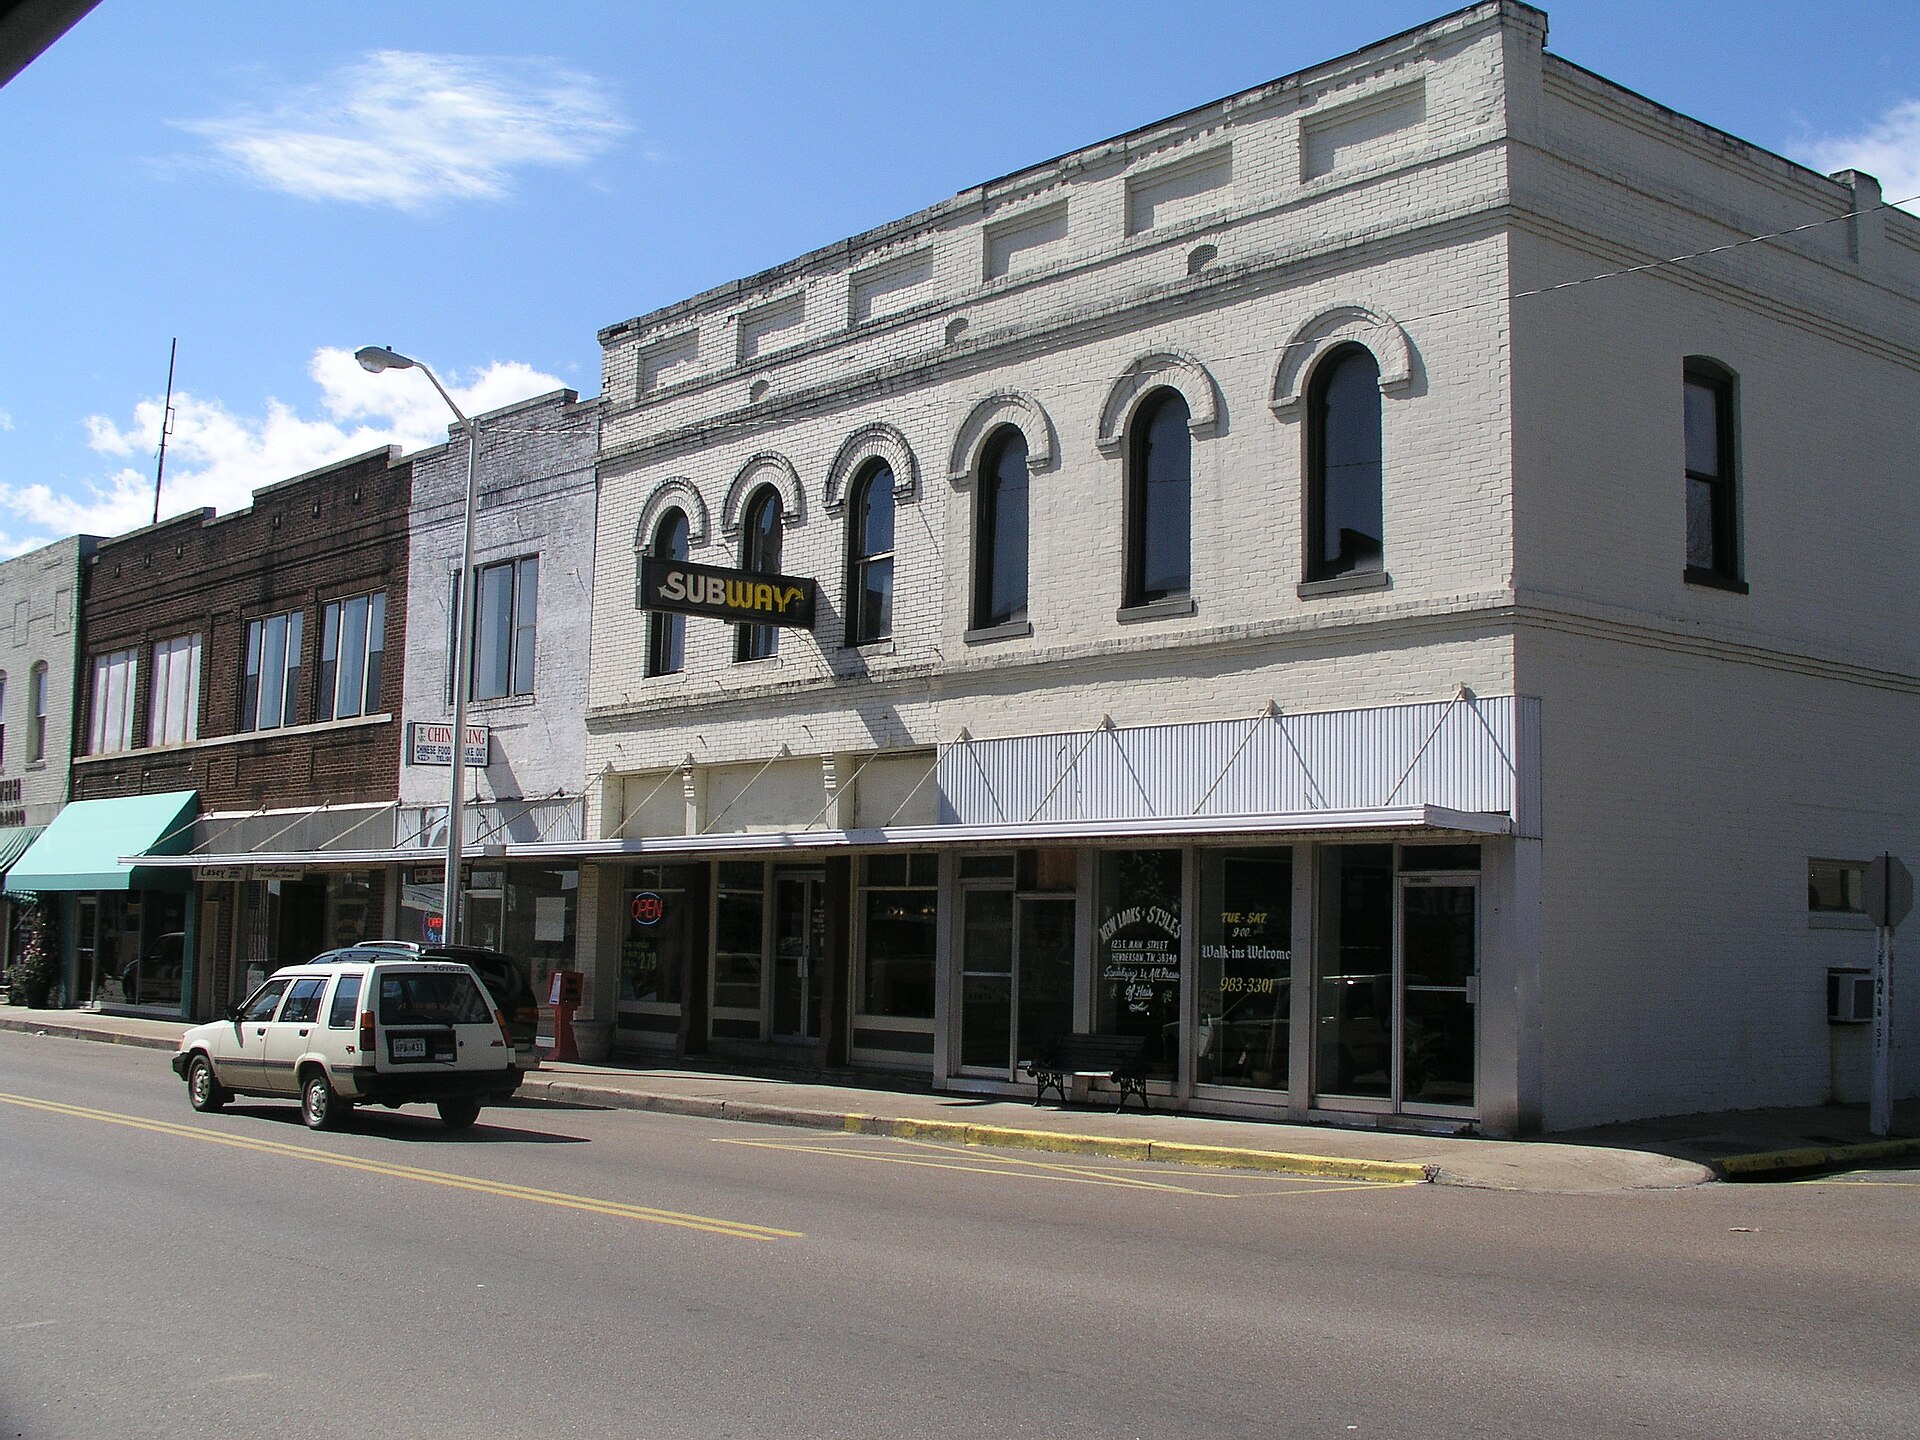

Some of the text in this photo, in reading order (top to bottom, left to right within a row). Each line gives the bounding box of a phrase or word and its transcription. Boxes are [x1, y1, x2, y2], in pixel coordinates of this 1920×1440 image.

[658, 571, 804, 613] SUBWAY
[416, 744, 436, 755] CHINESE
[630, 899, 662, 919] OPEN
[1099, 916, 1117, 943] NEW
[1146, 905, 1182, 939] STYLES
[1146, 940, 1169, 949] STREET
[1201, 944, 1292, 960] Walk-ins Welcome
[432, 964, 466, 972] TOYOTA
[1219, 977, 1274, 994] 983-3301
